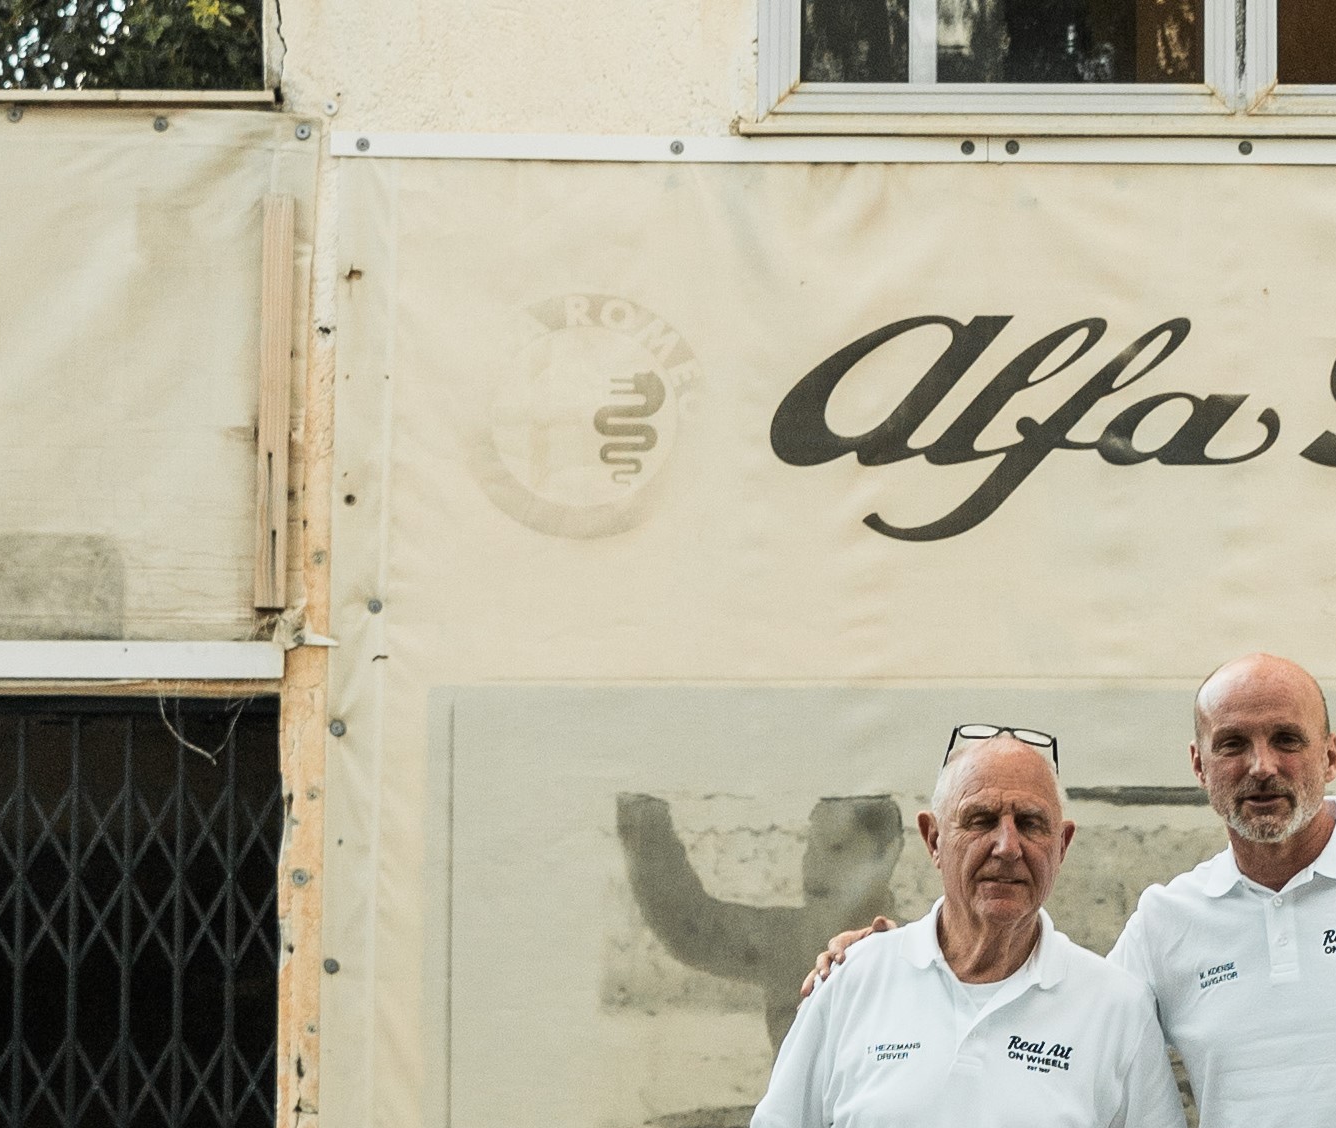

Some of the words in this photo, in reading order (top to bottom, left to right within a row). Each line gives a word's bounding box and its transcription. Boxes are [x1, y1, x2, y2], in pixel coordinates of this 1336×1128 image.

[769, 314, 1280, 542] Alfa
[1007, 1035, 1045, 1054] Real
[1046, 1043, 1073, 1059] Art
[1008, 1050, 1023, 1060] ON
[1026, 1054, 1069, 1070] WHEELS
